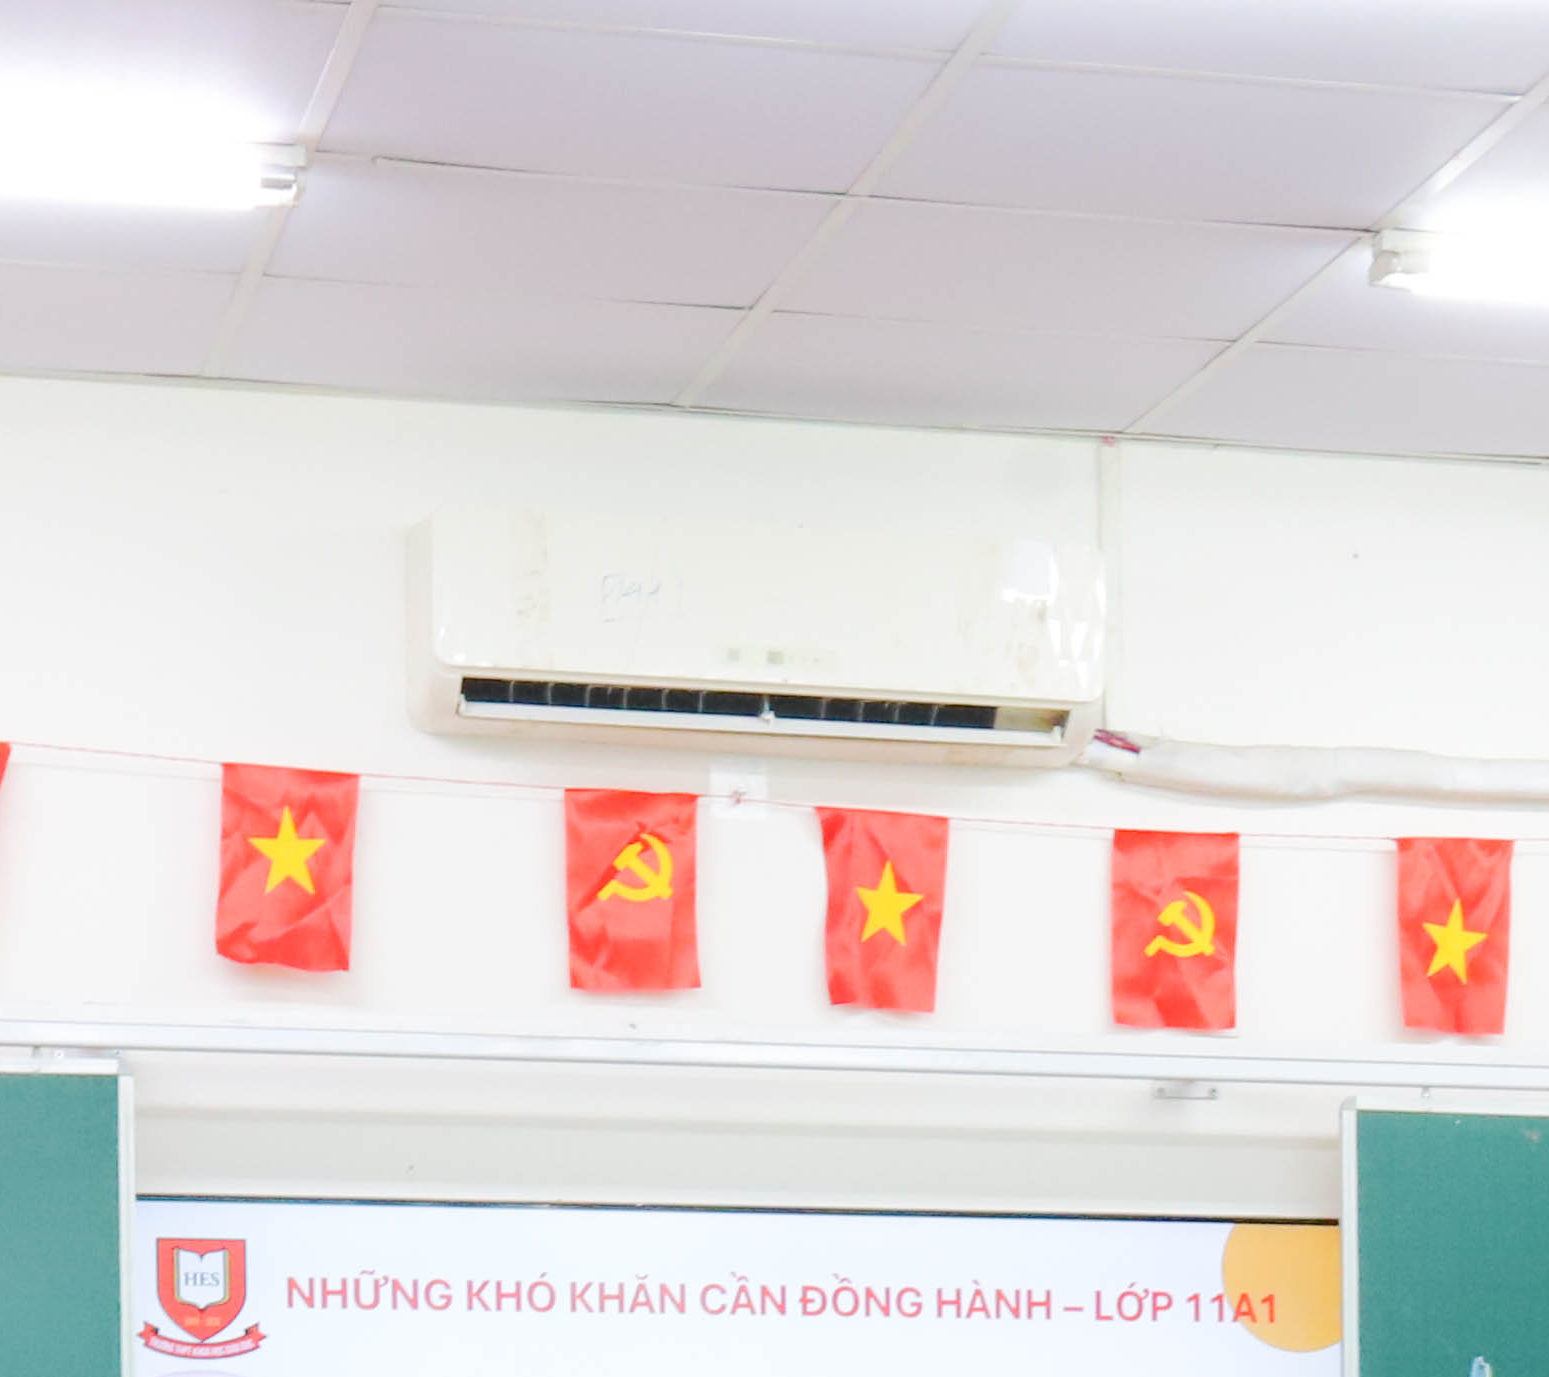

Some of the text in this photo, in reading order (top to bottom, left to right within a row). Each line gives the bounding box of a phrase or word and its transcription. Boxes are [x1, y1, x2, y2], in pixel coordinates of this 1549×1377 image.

[183, 1270, 221, 1288] HES
[286, 1269, 453, 1313] NHỮNG
[466, 1272, 557, 1314] KHÓ
[570, 1273, 687, 1316] KHĂN
[699, 1275, 788, 1318] CẦN
[798, 1277, 924, 1320] ĐỒNG
[935, 1279, 1052, 1322] HÀNH
[1094, 1282, 1174, 1323] LỚP
[1186, 1292, 1277, 1325] 11A1
